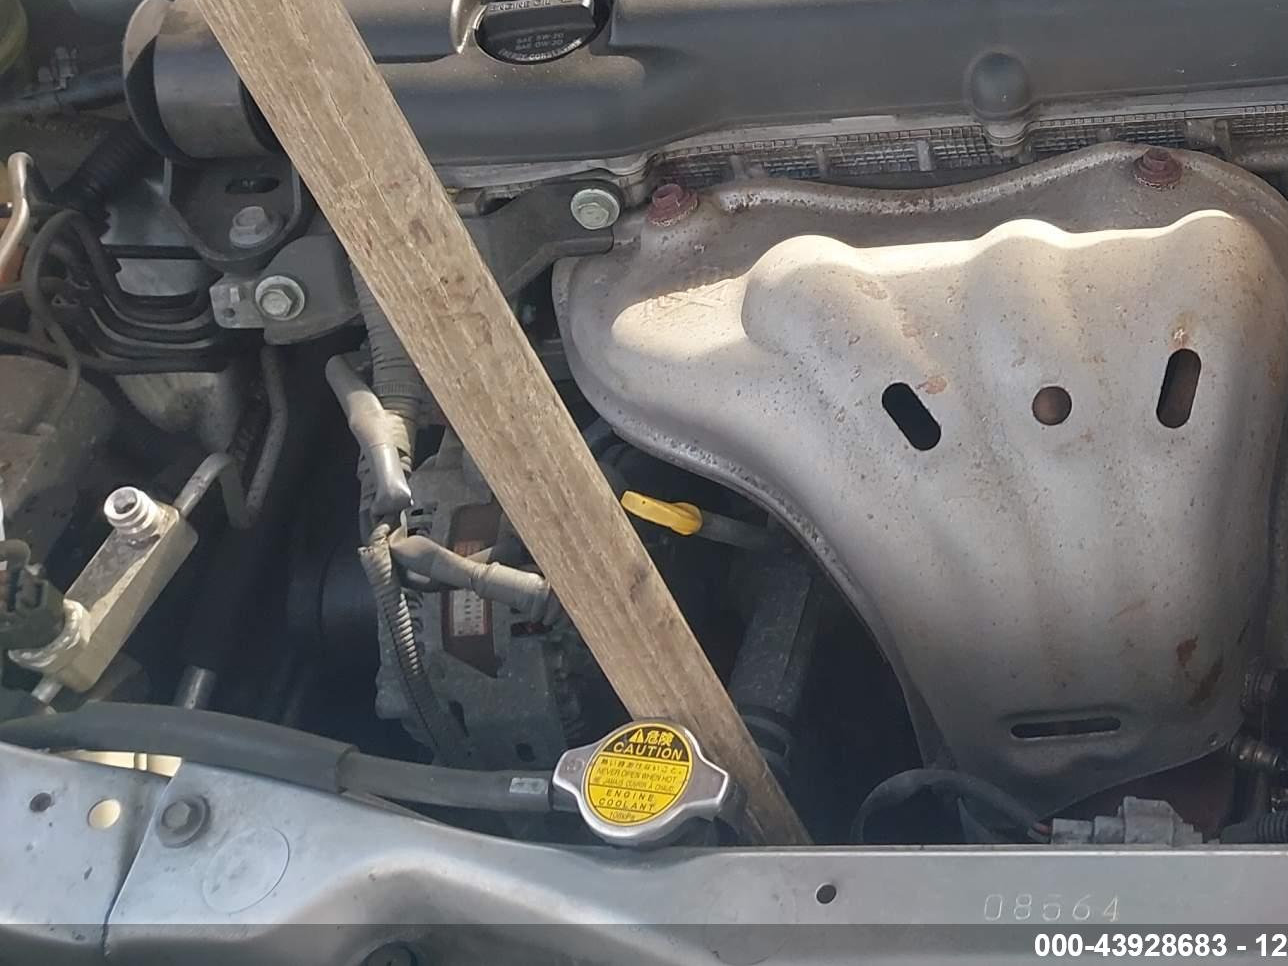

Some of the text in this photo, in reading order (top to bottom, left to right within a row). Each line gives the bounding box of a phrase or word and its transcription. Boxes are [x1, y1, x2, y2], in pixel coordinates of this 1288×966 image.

[613, 742, 683, 761] CAUTION
[606, 789, 655, 802] ENGINE
[598, 797, 655, 811] COOLANT
[983, 893, 1120, 922] 08564
